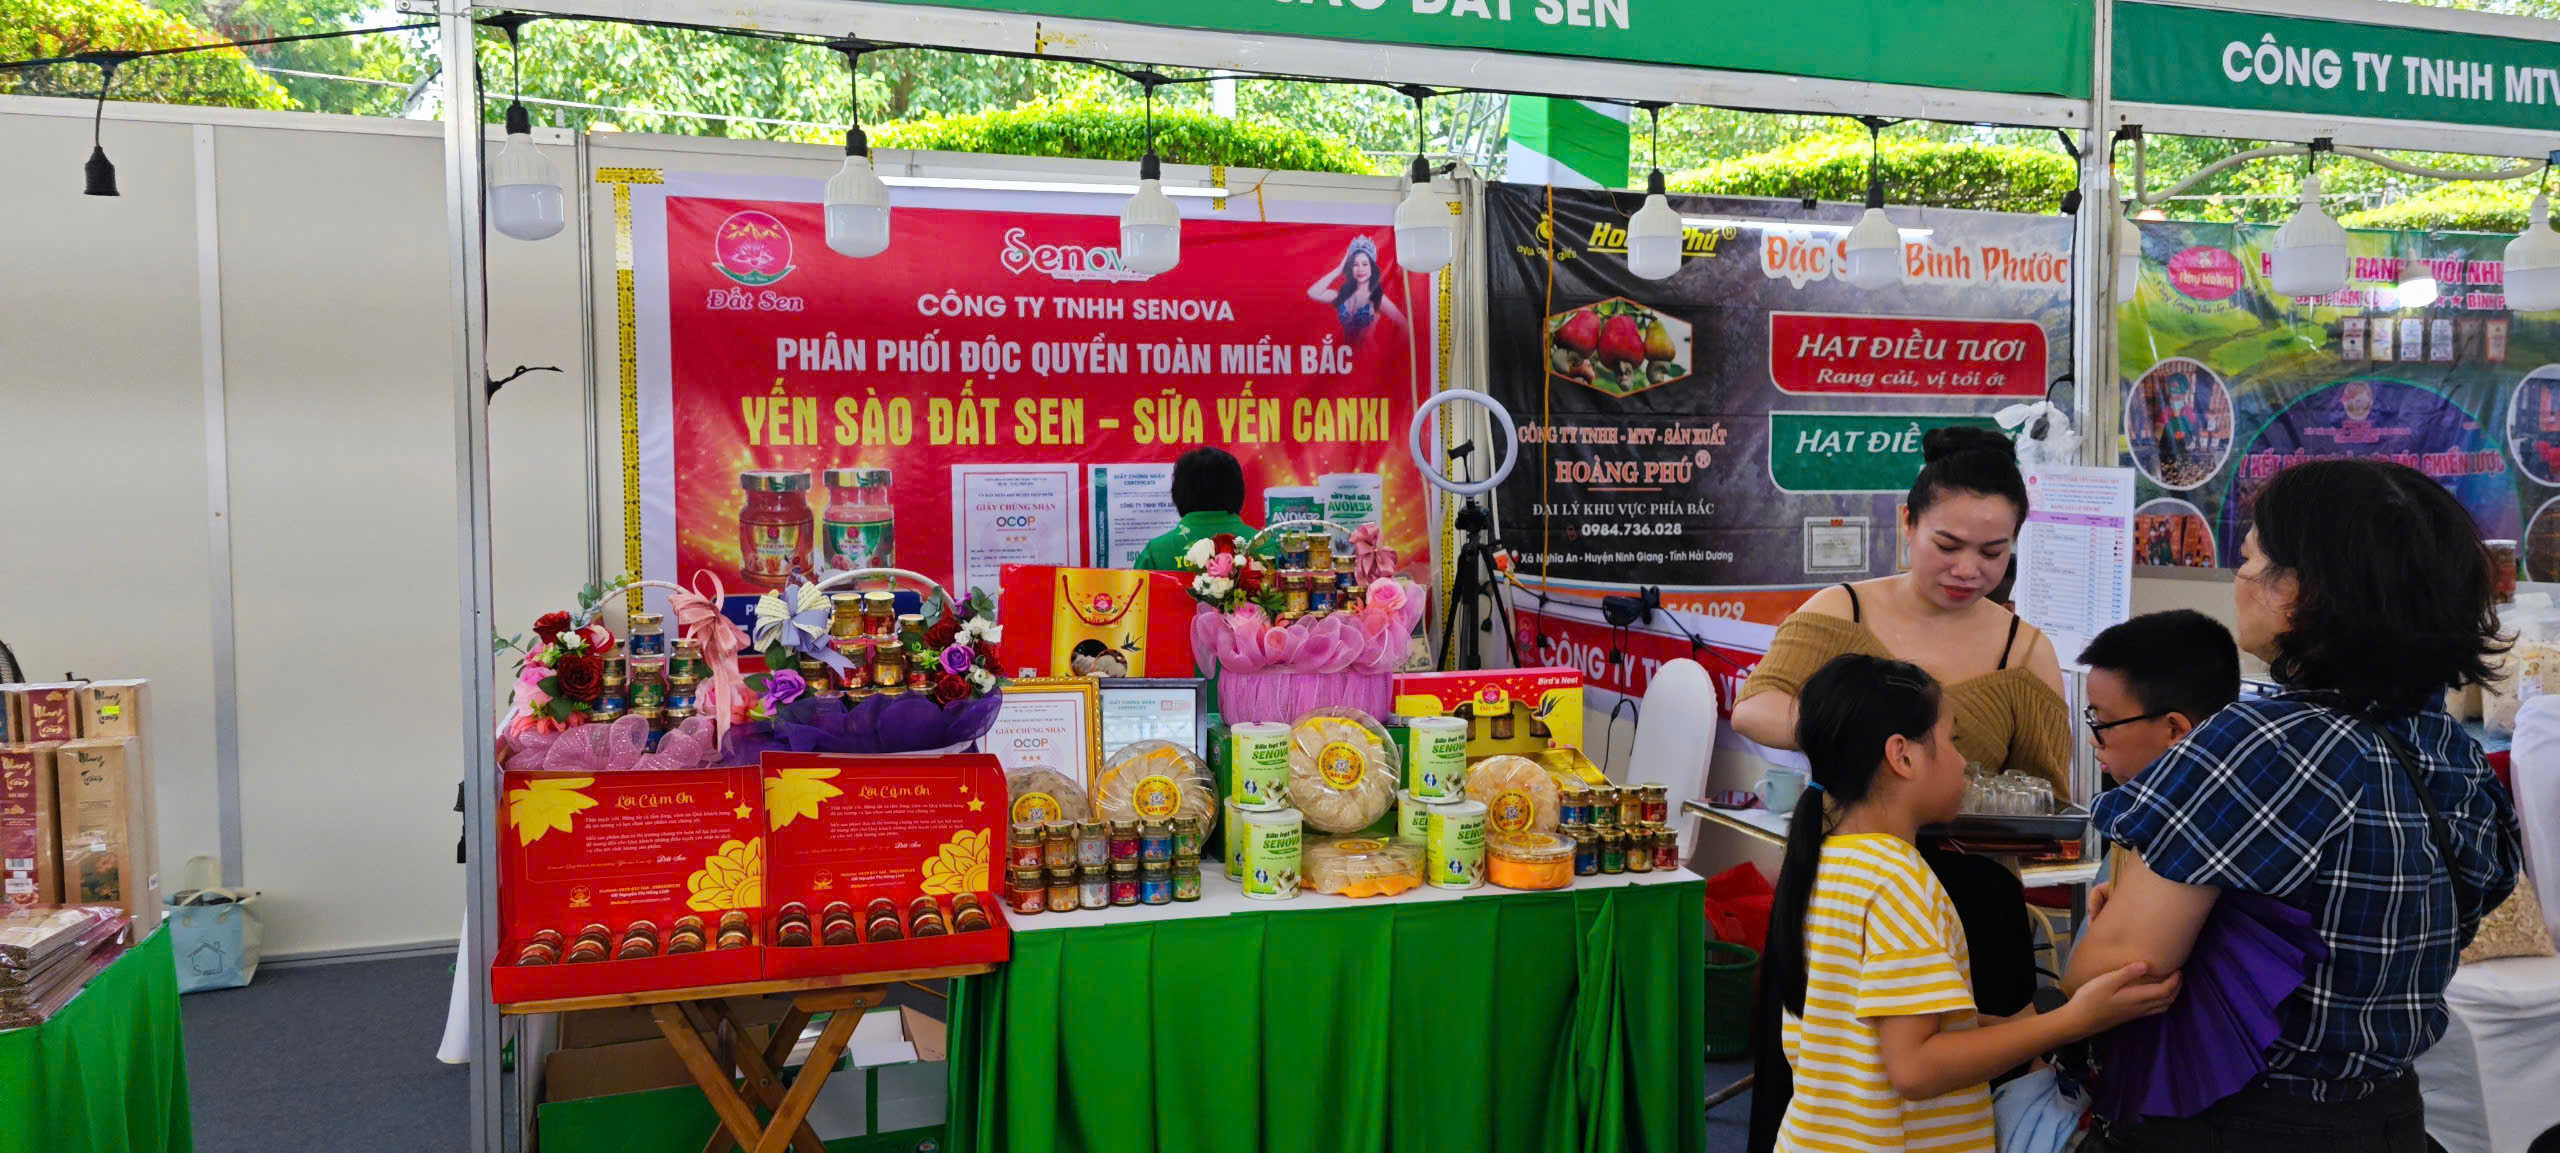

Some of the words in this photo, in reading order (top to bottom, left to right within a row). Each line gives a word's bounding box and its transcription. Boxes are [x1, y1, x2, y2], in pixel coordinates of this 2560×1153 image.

[2222, 33, 2343, 89] CÔNG
[2352, 52, 2392, 92] TY
[2402, 56, 2493, 101] TNHH
[1001, 227, 1136, 275] Senov
[1767, 235, 1826, 278] Đặc
[1905, 242, 1971, 280] Bình
[1982, 246, 2067, 284] Phước
[707, 287, 753, 310] Đất
[759, 290, 805, 312] Sen
[917, 288, 1007, 318] CÔNG
[1014, 296, 1046, 318] TY
[1052, 297, 1125, 320] TNHH
[1132, 299, 1235, 321] SENOVA
[777, 331, 866, 371] PHÂN
[877, 328, 951, 373] PHỐI
[960, 334, 1022, 380] ĐỘC
[1032, 332, 1128, 377] QUYỀN
[1137, 337, 1211, 374] TOÀN
[1220, 334, 1292, 375] MIỀN
[1301, 333, 1353, 375] BẮC
[1797, 334, 1866, 362] HẠT
[1870, 328, 1945, 362] ĐIỀU
[1951, 338, 2026, 363] TƯƠI
[1816, 369, 1874, 387] Rang
[1927, 371, 1945, 388] vị
[1951, 370, 1980, 386] tỏi
[1986, 369, 2005, 387] ớt
[742, 377, 818, 446] YẾN
[834, 387, 913, 446] SÀO
[928, 379, 1000, 445] ĐẤT
[1014, 397, 1084, 445] SEN
[1133, 387, 1203, 444] SỮA
[1217, 381, 1281, 443] YẾN
[1293, 397, 1389, 443] CANXI
[1518, 421, 1557, 444] CÔNG
[1560, 426, 1578, 444] TY
[1580, 427, 1619, 444] TNHH
[1627, 427, 1657, 445] MTV
[1663, 422, 1692, 445] SẢN
[1692, 421, 1727, 445] XUẤT
[1795, 429, 1864, 457] HẠT
[1867, 422, 1922, 453] ĐIỀ
[1555, 454, 1639, 483] HOÀNG
[1644, 455, 1693, 483] PHÚ
[1562, 499, 1579, 516] LÝ
[1583, 502, 1614, 516] KHU
[1618, 502, 1647, 518] VỰC
[1650, 499, 1684, 516] PHÍA
[1687, 498, 1715, 515] BẮC
[997, 515, 1036, 527] OCOP
[1581, 523, 1682, 536] 0984.736.028
[1521, 551, 1534, 563] Xã
[1565, 553, 1578, 563] An
[1584, 552, 1614, 566] Huyện
[1615, 551, 1635, 563] Ninh
[1636, 551, 1664, 565] Giang
[1669, 549, 1687, 562] Tỉnh
[1688, 548, 1704, 561] Hải
[1705, 550, 1733, 564] Dương
[1538, 676, 1560, 686] Bird's
[1561, 676, 1578, 685] Nest
[1013, 738, 1049, 748] OCOP
[1432, 743, 1465, 754] SENOV
